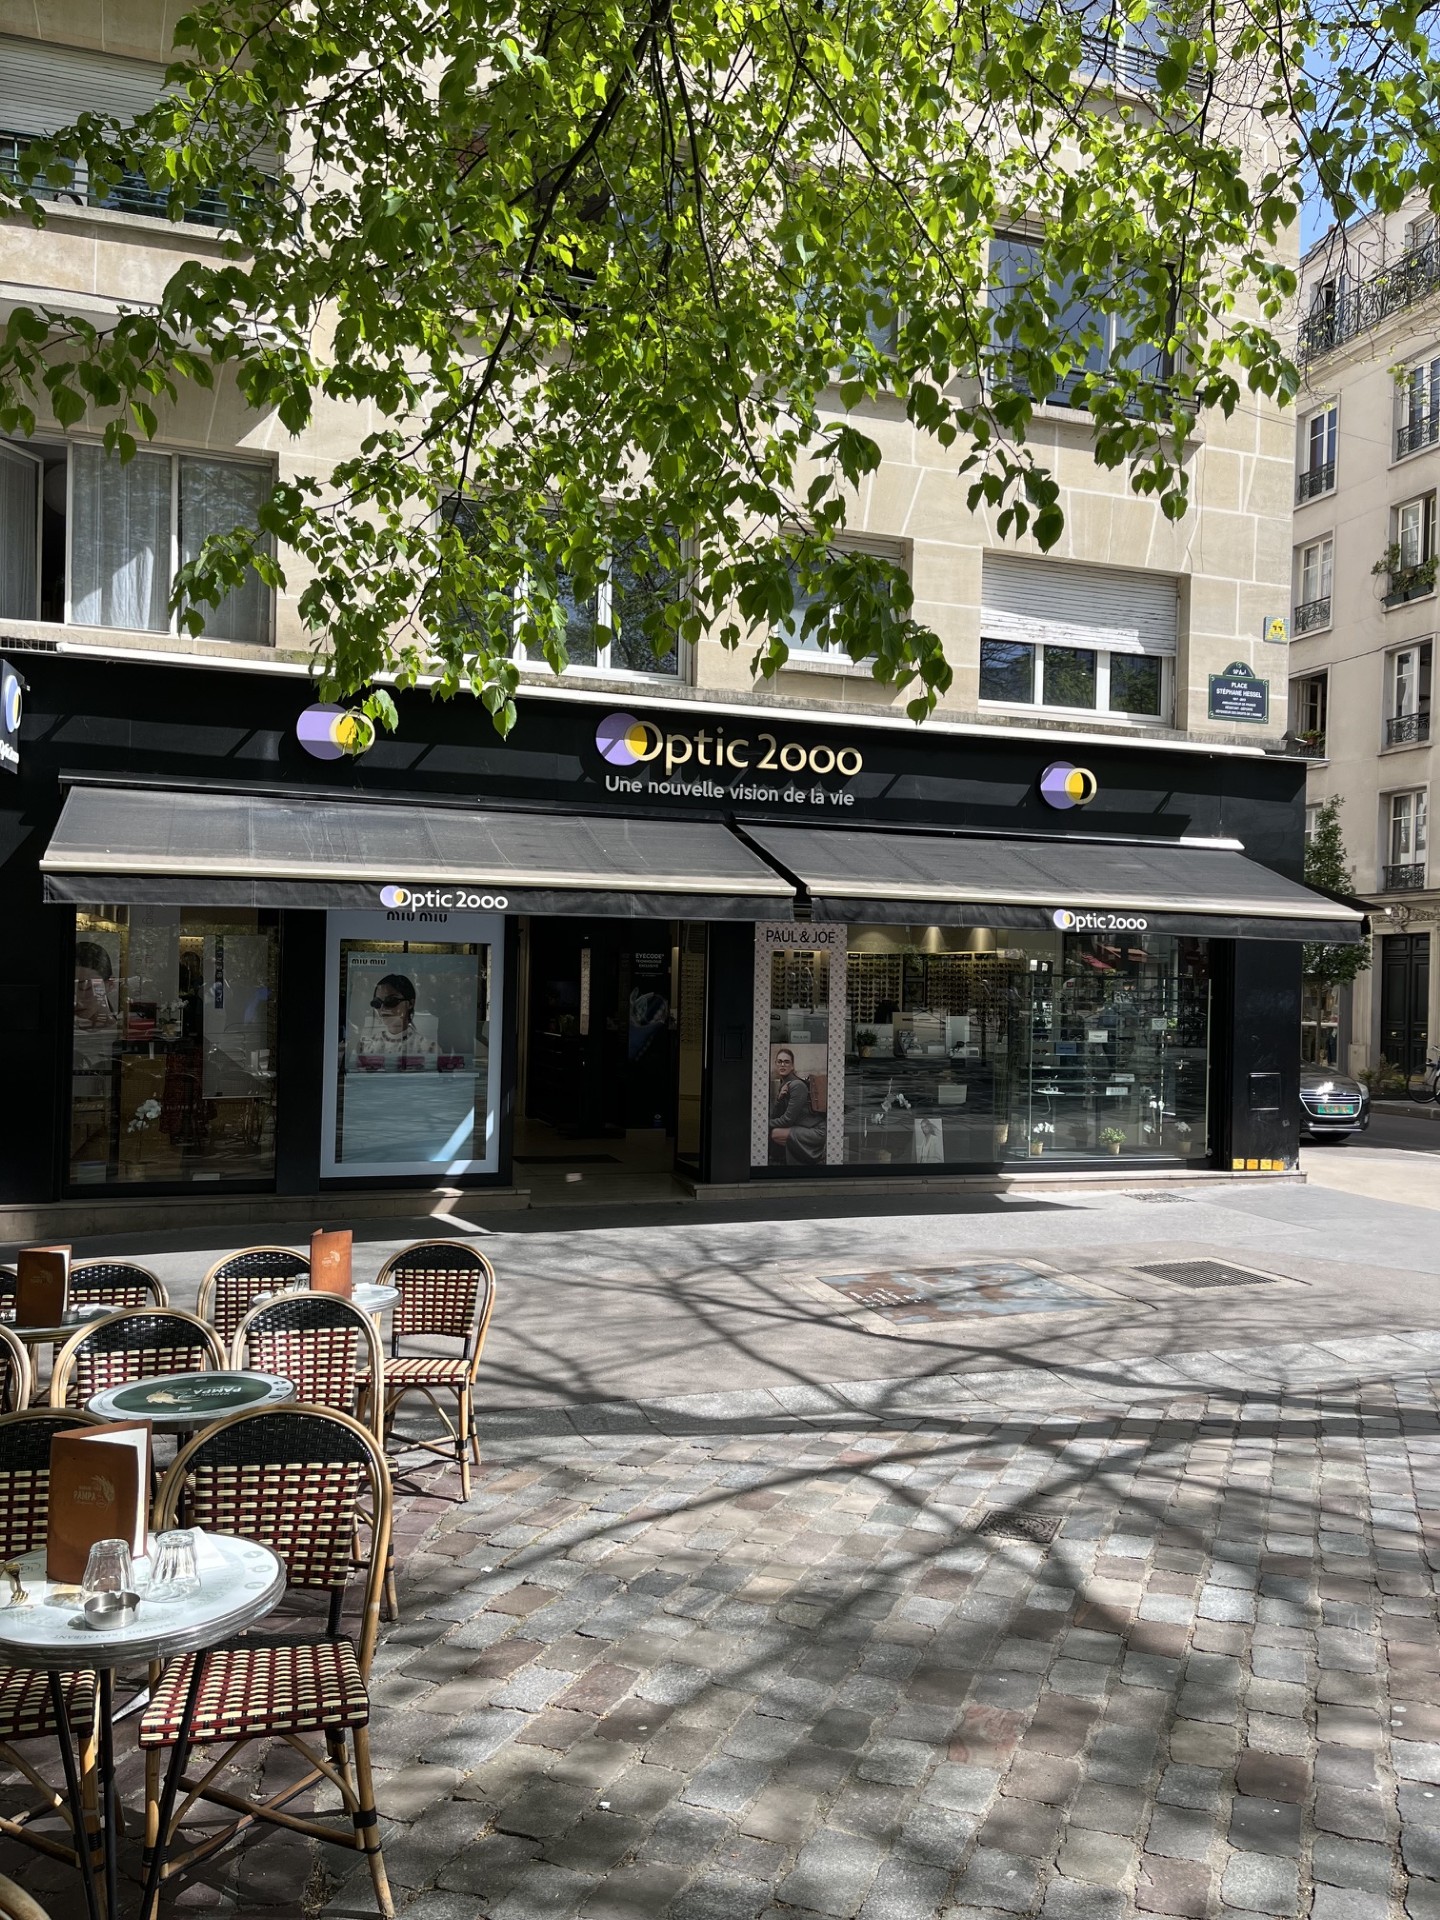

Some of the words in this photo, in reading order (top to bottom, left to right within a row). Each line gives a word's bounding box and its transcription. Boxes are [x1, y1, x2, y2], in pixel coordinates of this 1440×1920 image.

[1216, 688, 1242, 696] STÉPHANE
[1243, 690, 1262, 698] HESSEL
[624, 720, 749, 776] Optic
[756, 733, 863, 776] 2000
[605, 775, 642, 793] Une
[648, 779, 724, 798] nouvelle
[730, 784, 779, 802] vision
[783, 787, 805, 803] de
[810, 788, 824, 805] la
[829, 790, 855, 806] vie
[393, 888, 453, 912] Optic
[455, 891, 508, 910] 2000
[1062, 911, 1106, 932] Optic
[1107, 914, 1148, 930] 2000
[766, 929, 798, 943] PAUL
[800, 930, 810, 943] &
[811, 931, 836, 944] JOE
